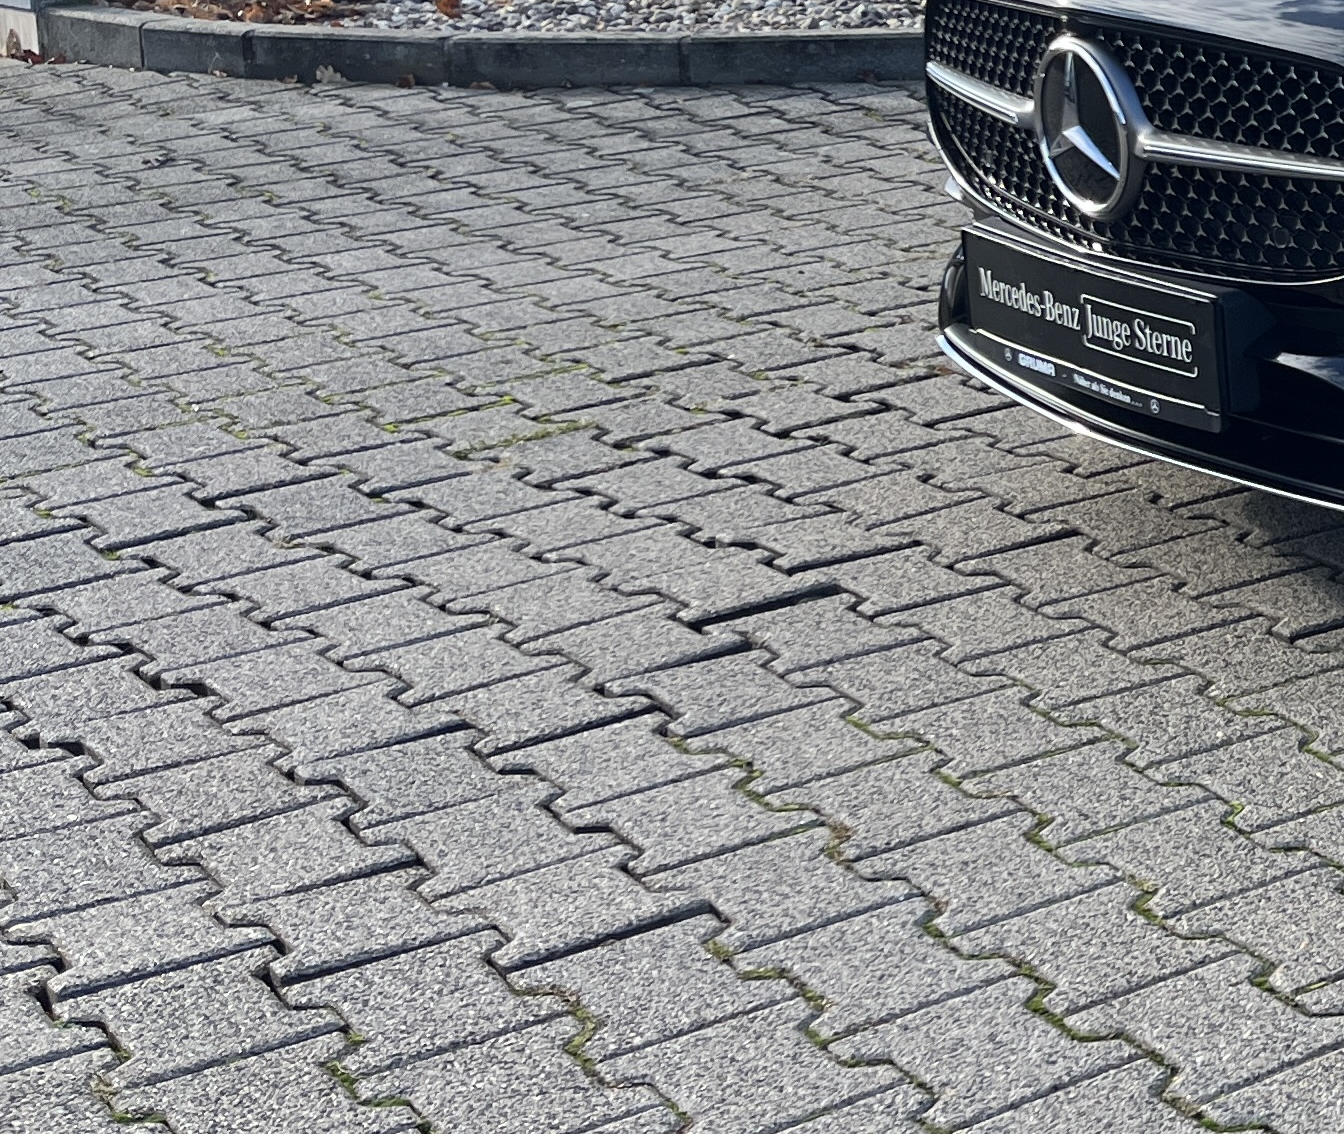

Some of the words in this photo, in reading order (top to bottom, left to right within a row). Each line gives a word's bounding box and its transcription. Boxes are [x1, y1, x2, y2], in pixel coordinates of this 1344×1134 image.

[977, 266, 1081, 331] Mercedes-Benz
[1084, 303, 1131, 351] Junge
[1133, 317, 1193, 363] Sterne
